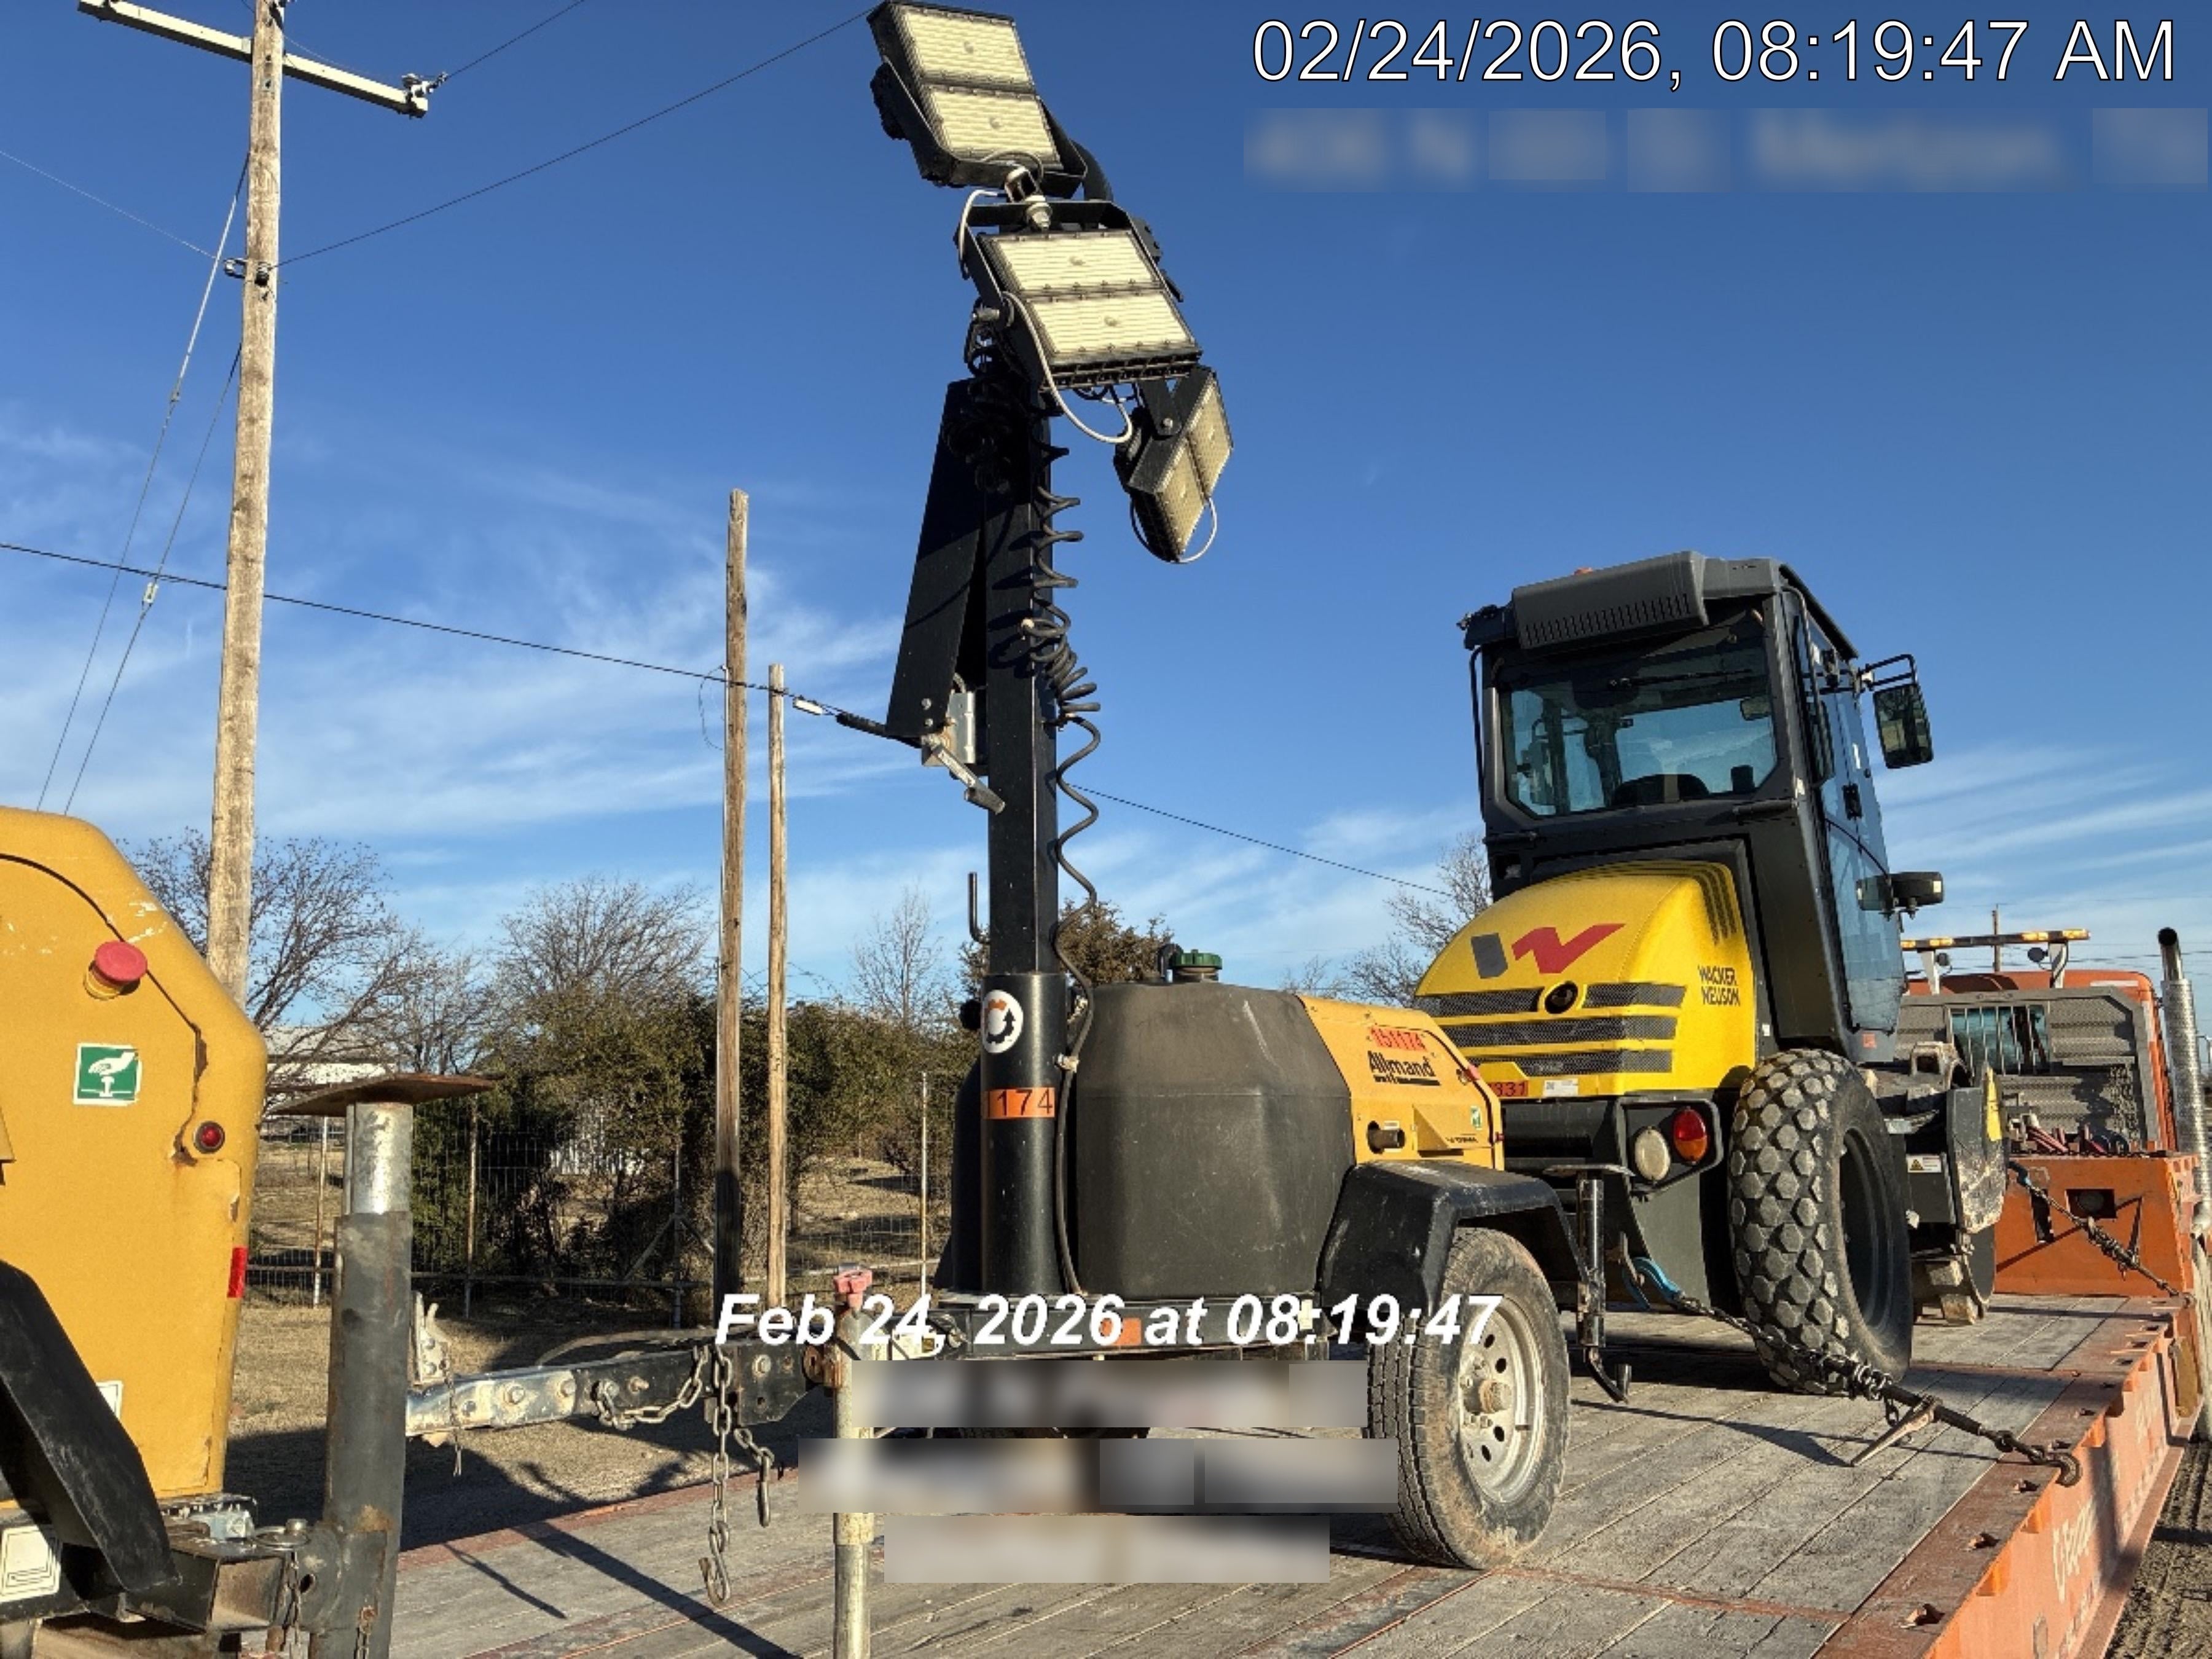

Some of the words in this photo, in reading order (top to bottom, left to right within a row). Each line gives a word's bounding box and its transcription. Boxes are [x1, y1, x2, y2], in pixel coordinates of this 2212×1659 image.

[1698, 965, 1738, 986] WACKER
[1701, 986, 1740, 1006] NEUSON
[1368, 1050, 1436, 1077] Allmand
